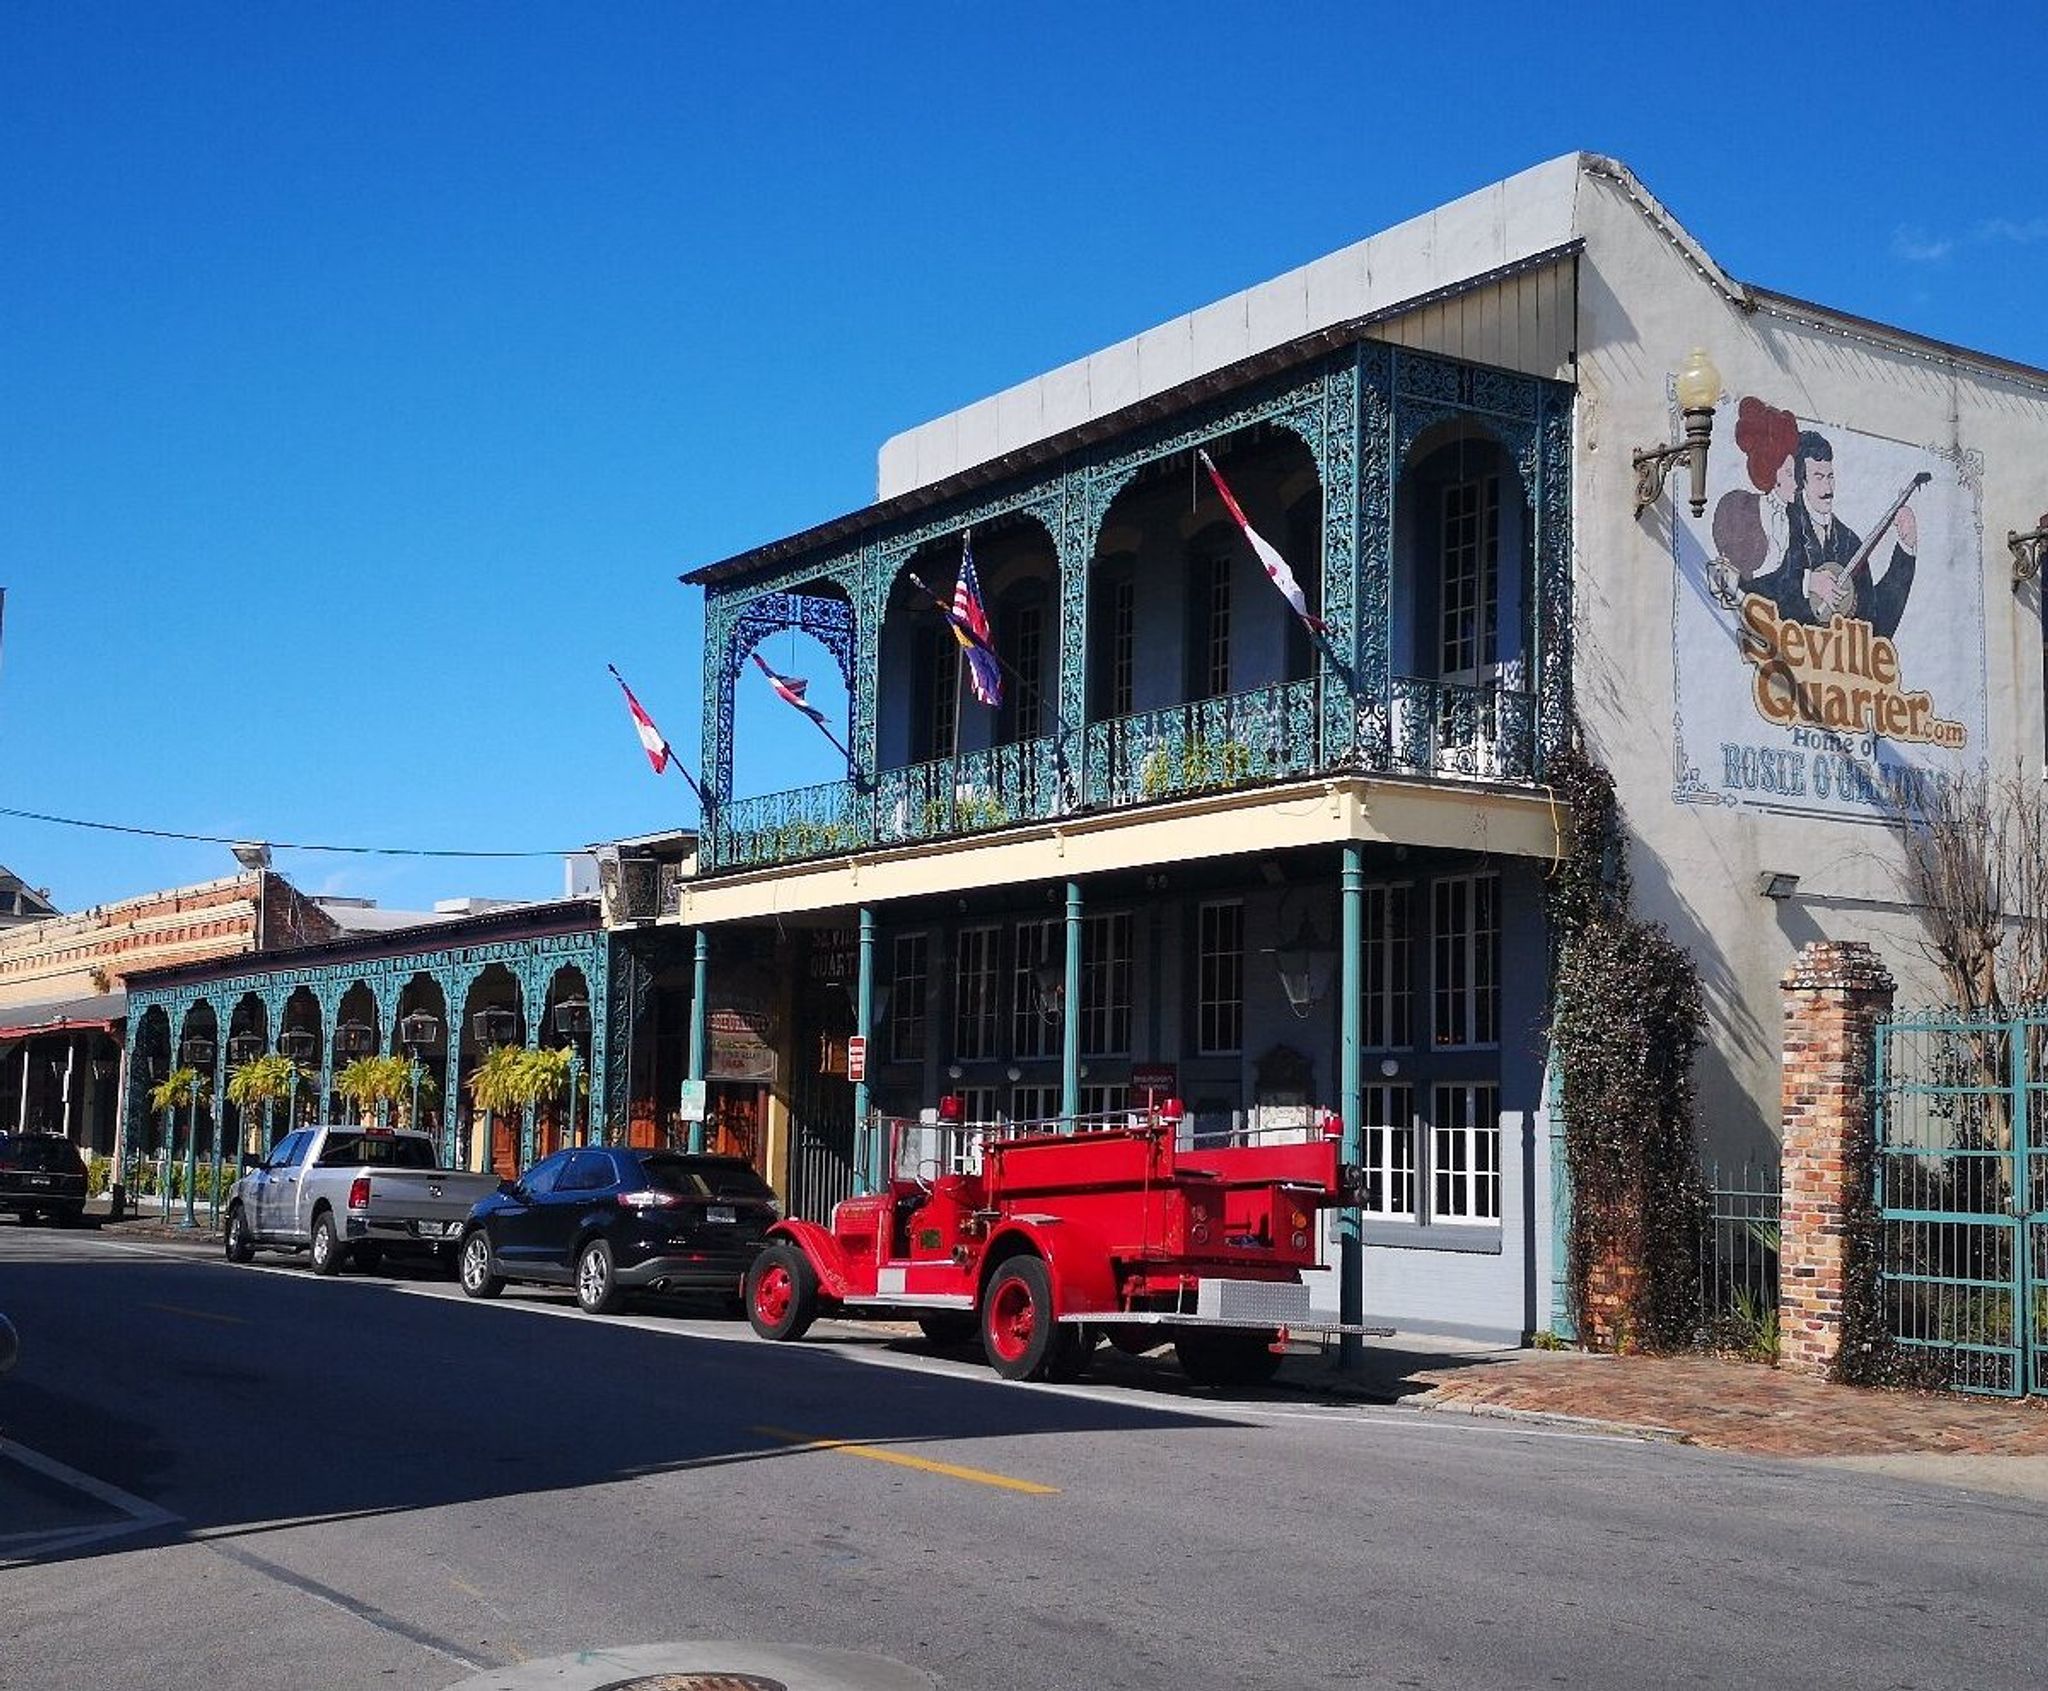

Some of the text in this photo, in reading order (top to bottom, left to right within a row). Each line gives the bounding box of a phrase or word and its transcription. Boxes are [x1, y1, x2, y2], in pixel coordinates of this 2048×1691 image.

[1743, 597, 1897, 685] Seville
[1792, 728, 1854, 755] Home
[1721, 742, 1806, 797] ROSIE
